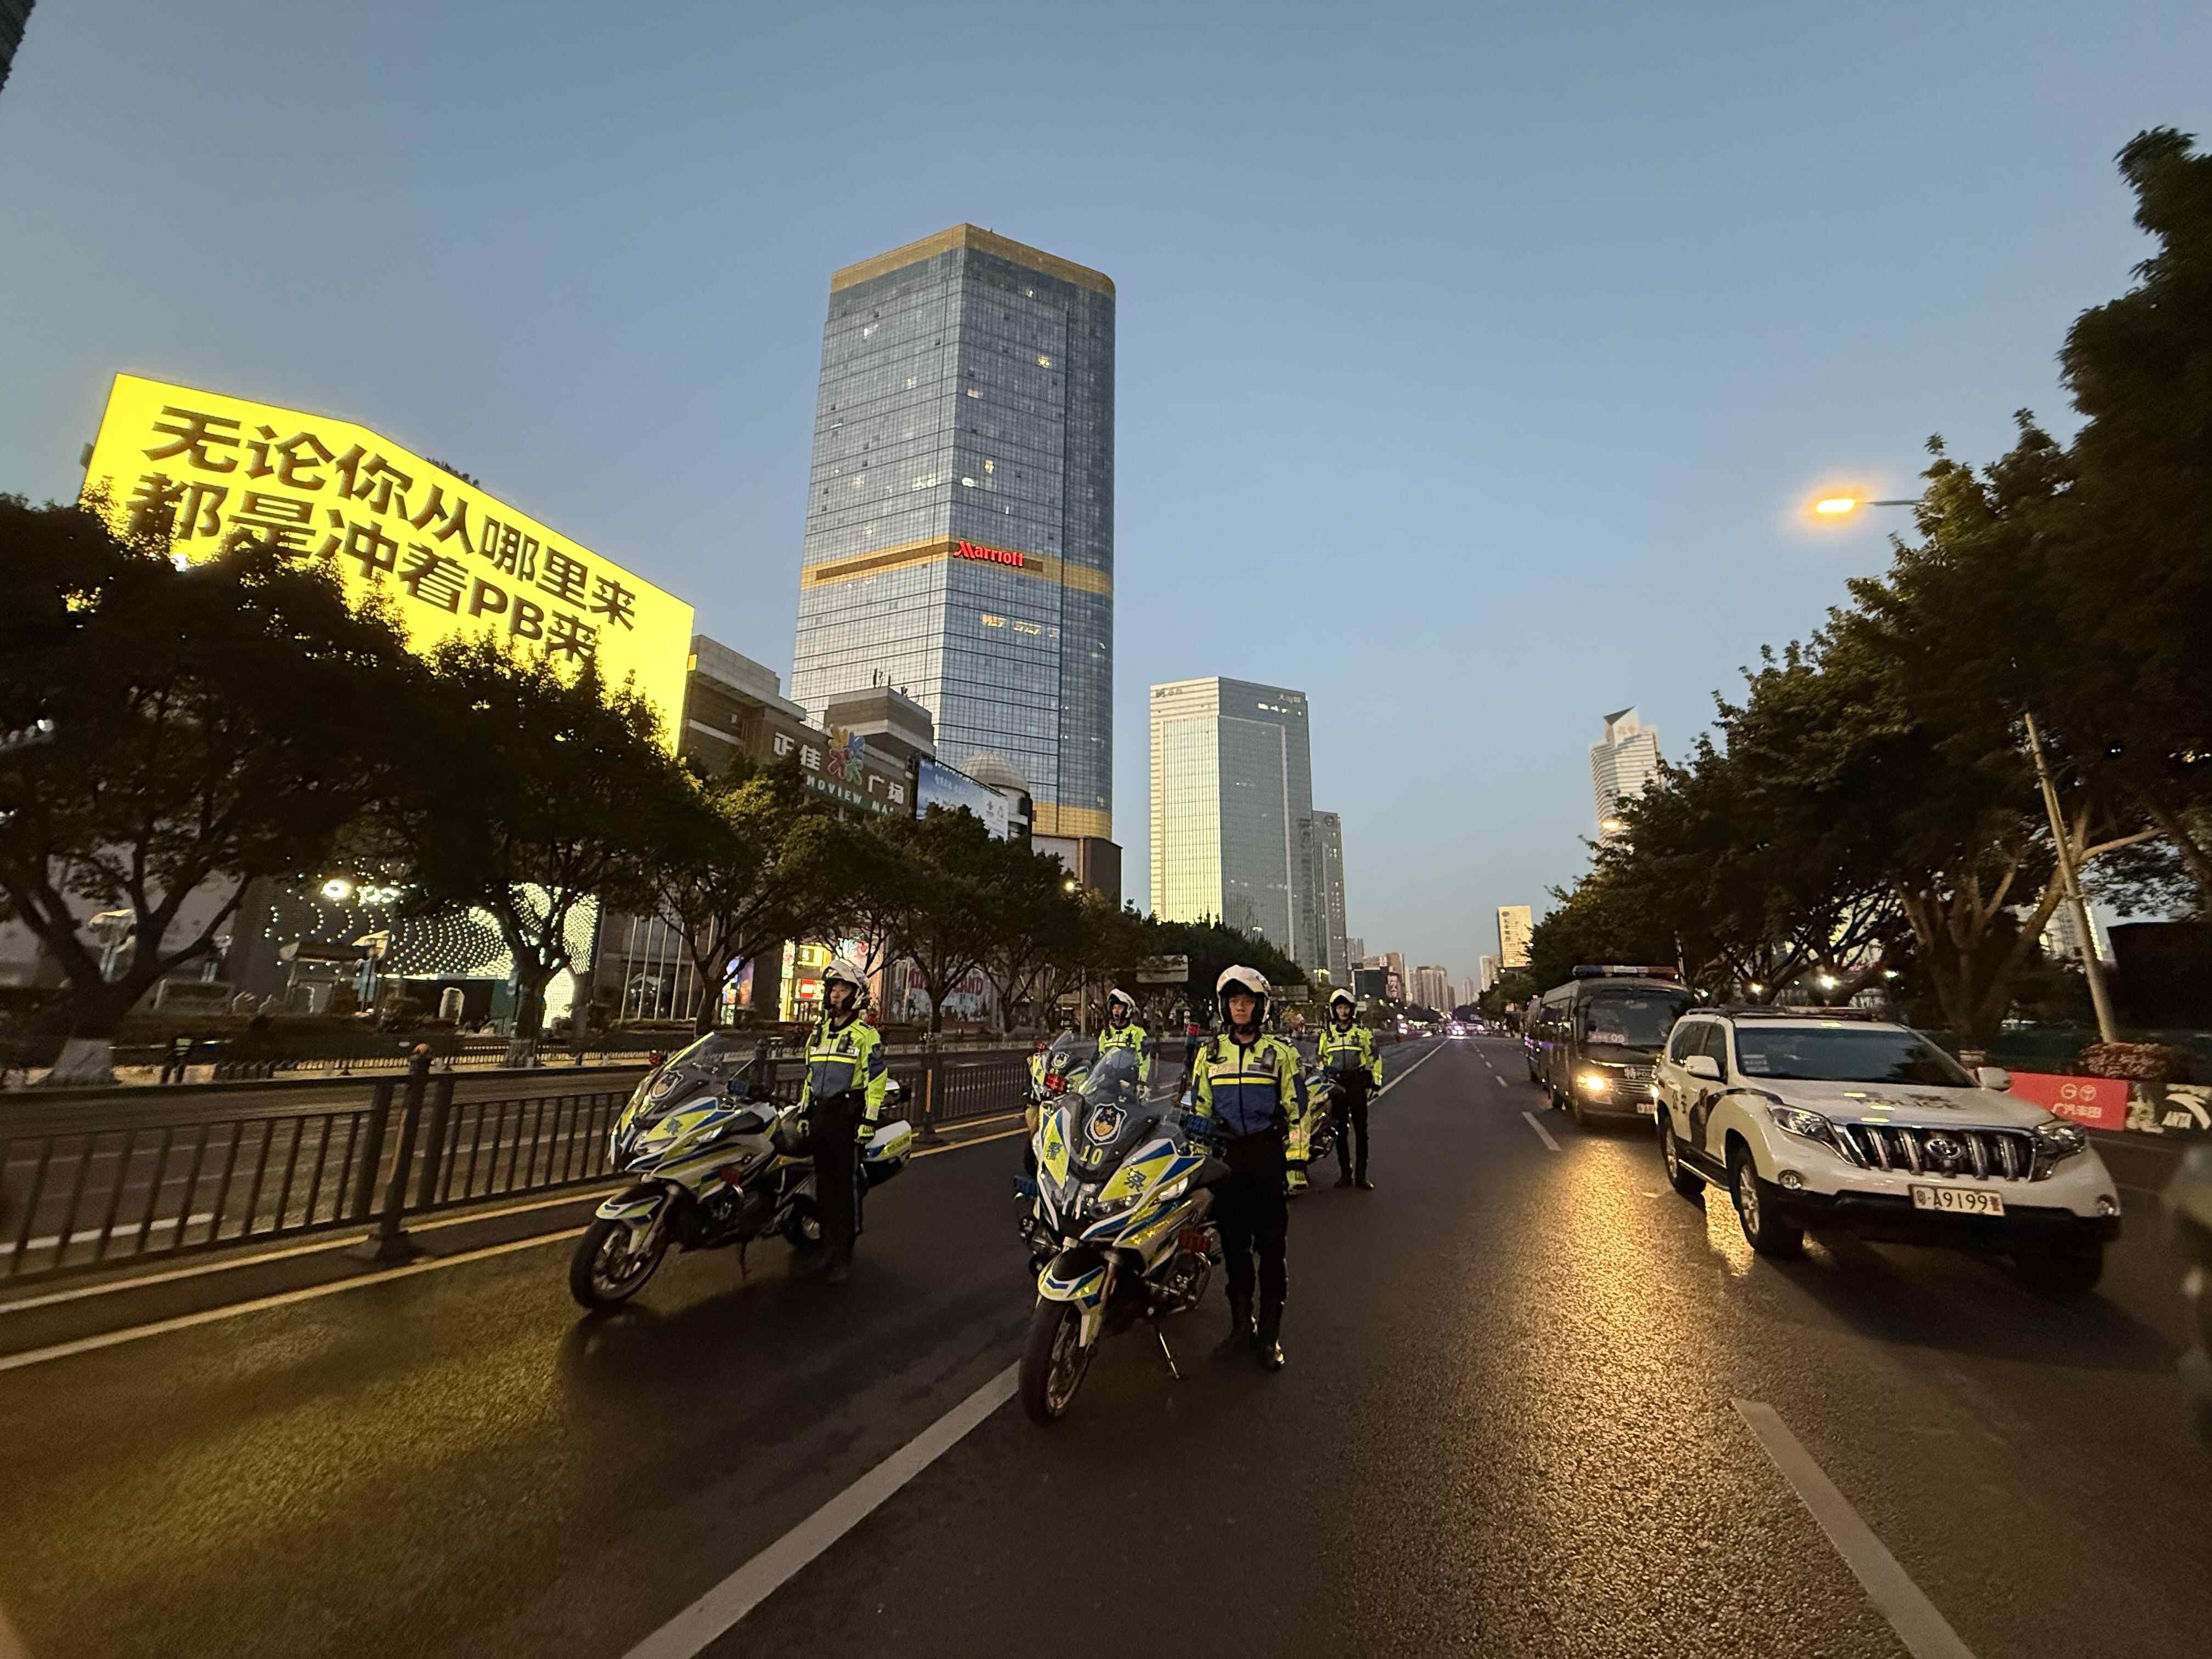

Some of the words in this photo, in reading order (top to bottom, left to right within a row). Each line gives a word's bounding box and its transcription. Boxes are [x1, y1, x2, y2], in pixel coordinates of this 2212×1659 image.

[126, 472, 596, 662] 都是冲着PB来
[141, 405, 636, 631] 无论你从哪里来
[953, 540, 1024, 567] Marriott
[1080, 1144, 1103, 1166] 10
